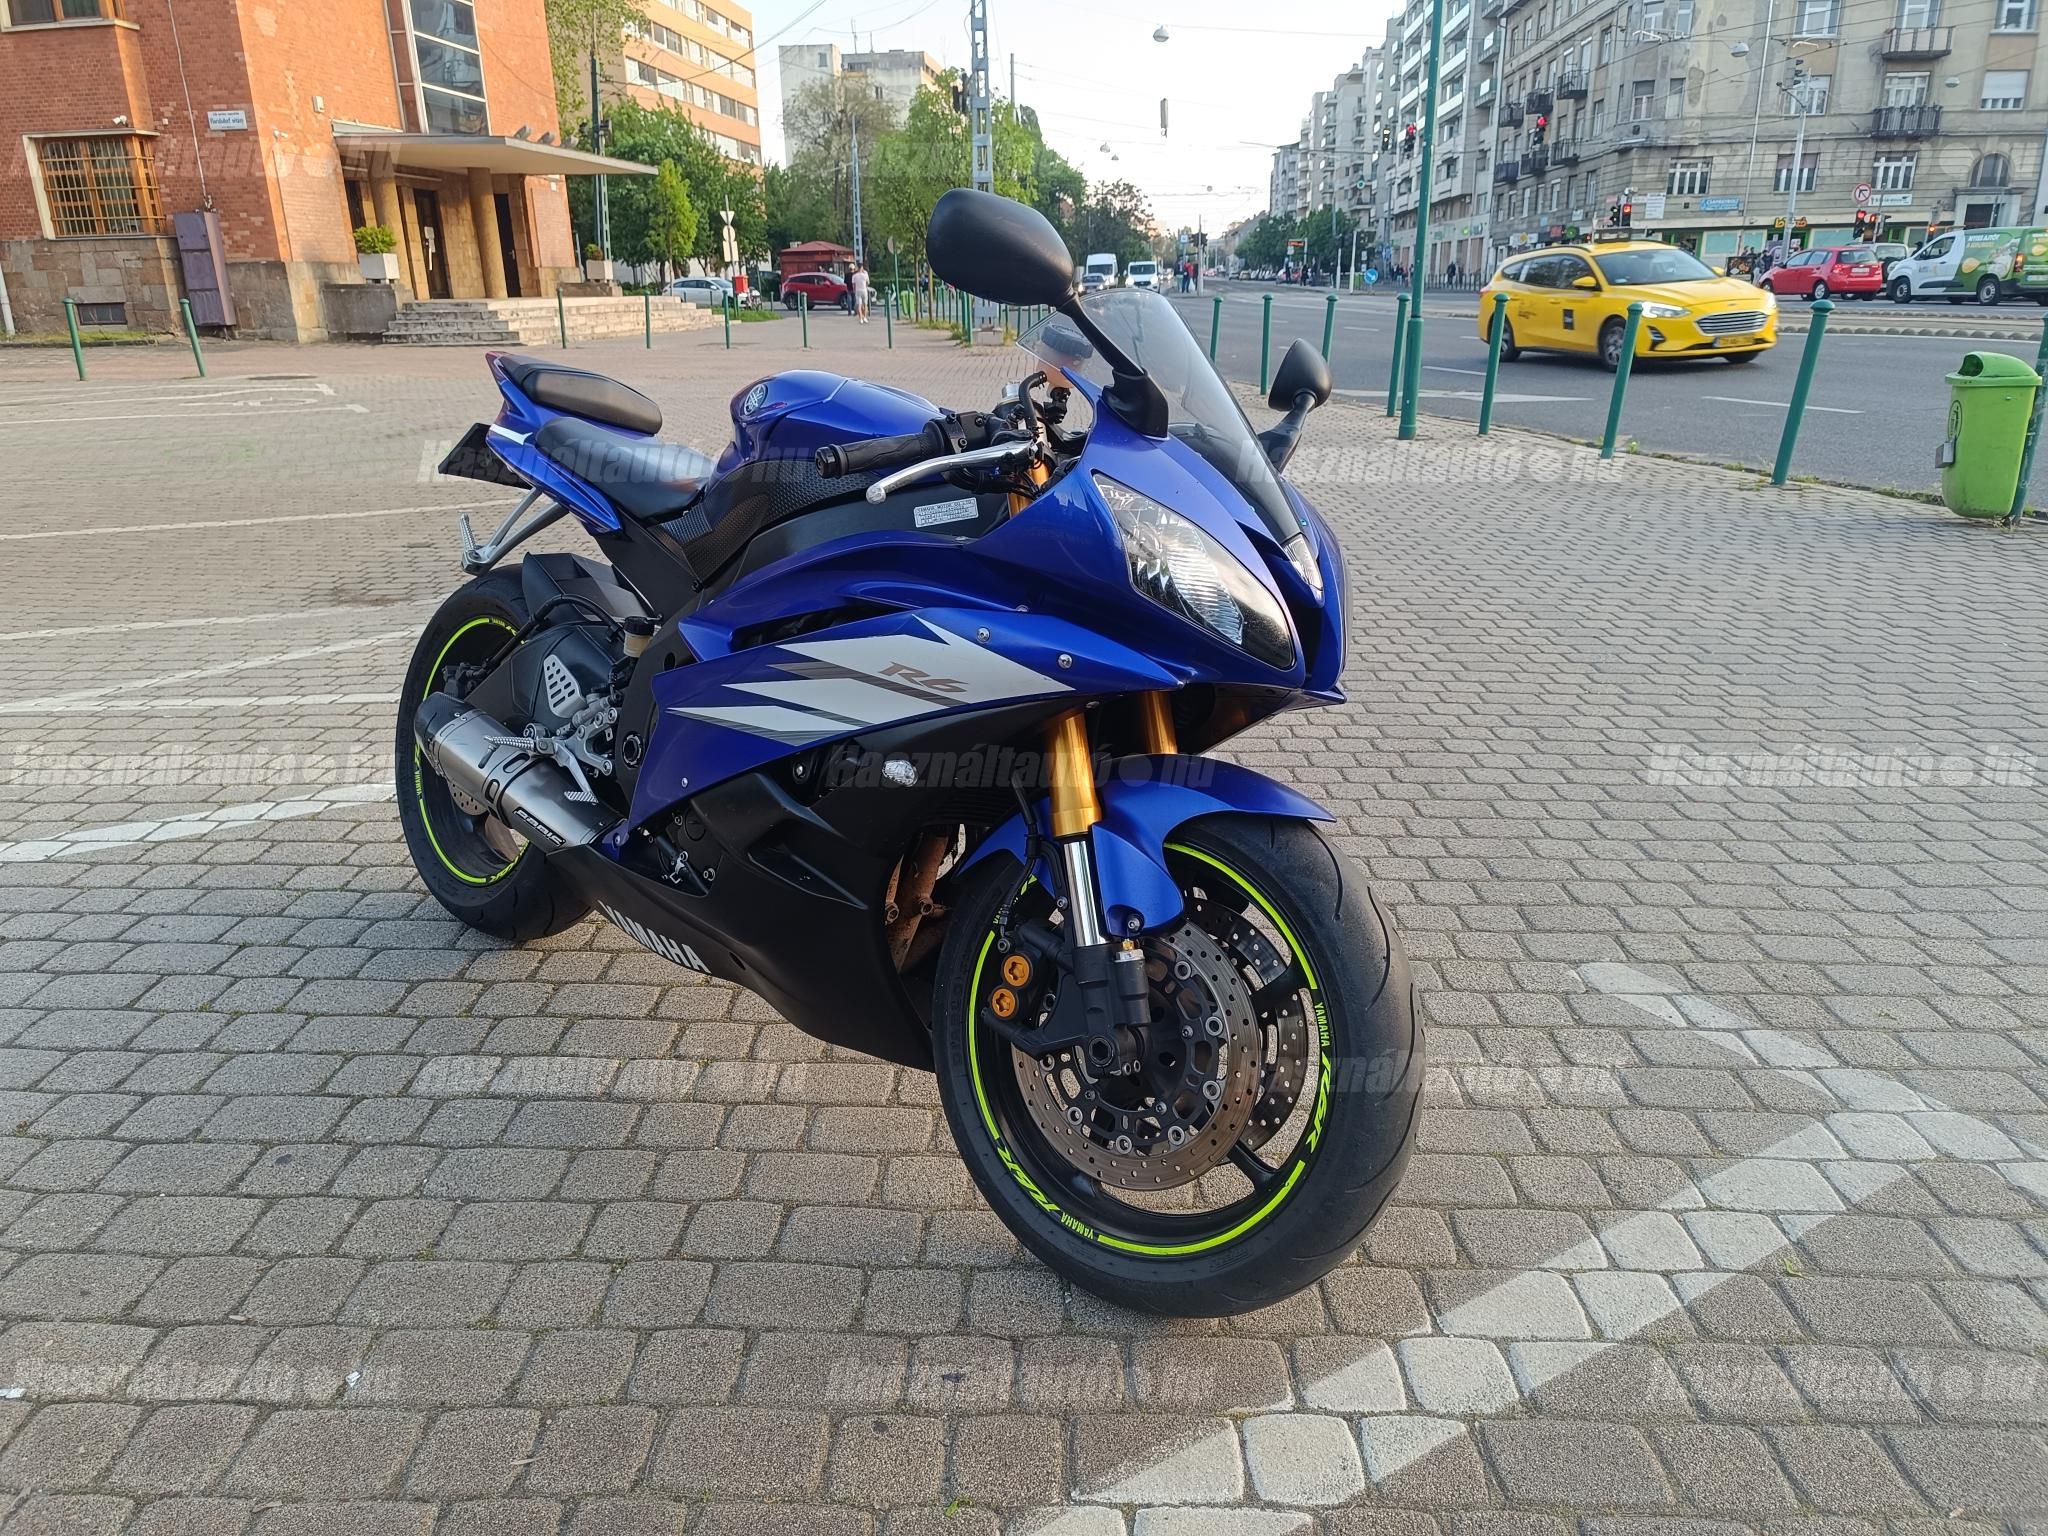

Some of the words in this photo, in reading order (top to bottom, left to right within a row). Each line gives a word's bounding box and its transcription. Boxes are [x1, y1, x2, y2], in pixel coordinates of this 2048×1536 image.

[878, 661, 968, 692] R6
[597, 900, 712, 974] YAMAHA
[1314, 1002, 1331, 1047] YAMAHA
[1061, 1212, 1095, 1240] YAMAHA
